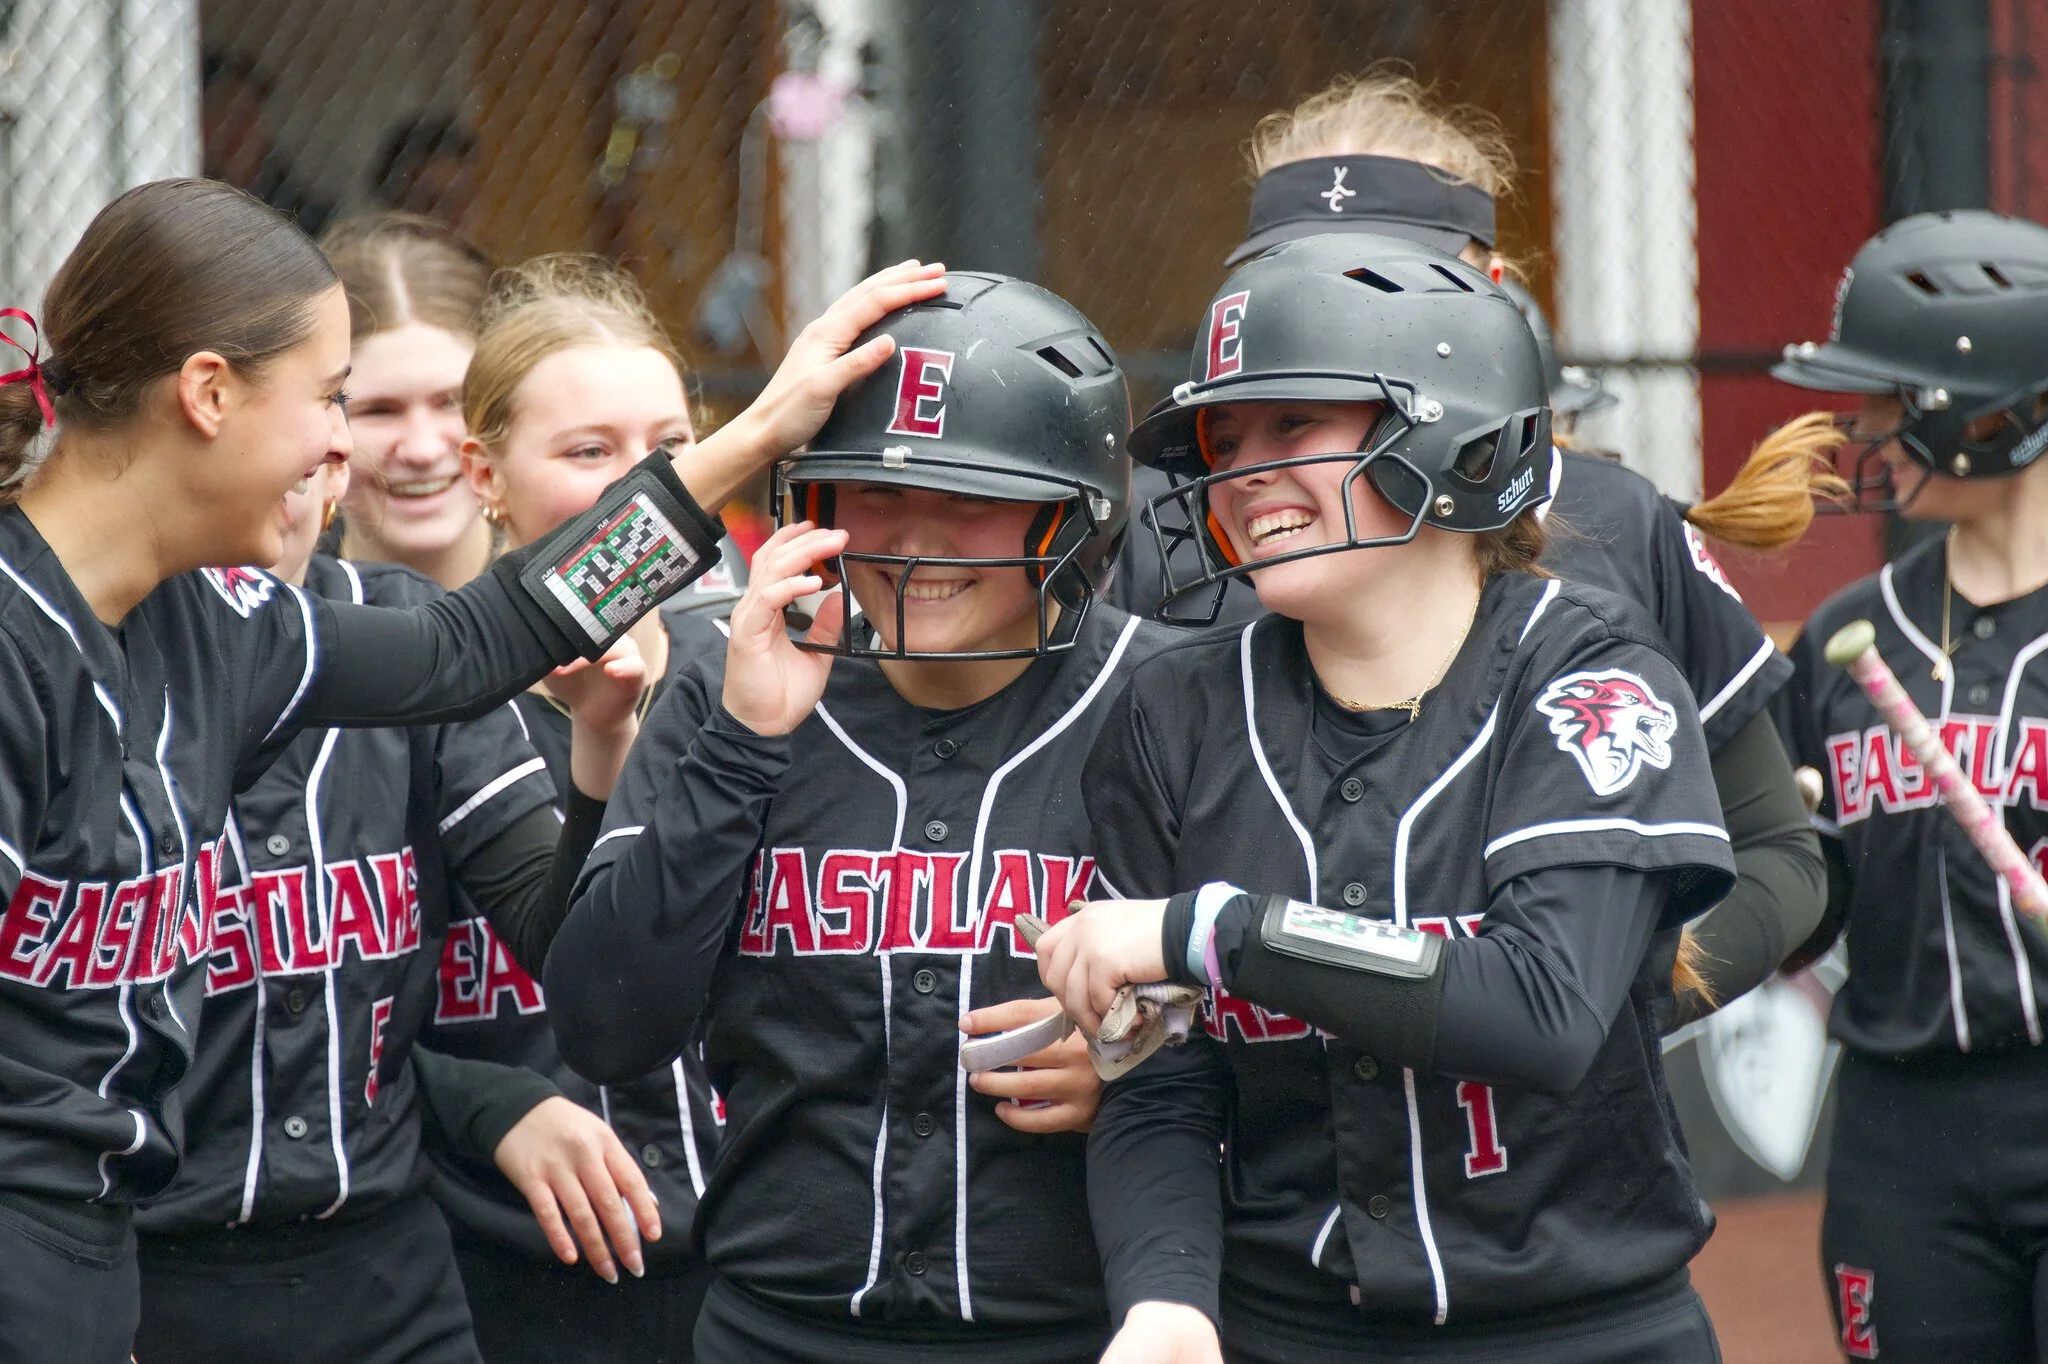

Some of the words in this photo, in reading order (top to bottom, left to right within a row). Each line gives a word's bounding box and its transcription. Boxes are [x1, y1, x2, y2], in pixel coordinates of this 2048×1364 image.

[1205, 290, 1250, 381] E
[885, 346, 955, 439] E
[1498, 466, 1534, 512] schutt
[1825, 712, 2048, 828] EASTLA
[738, 846, 1097, 959] EASTLAK
[1456, 1080, 1507, 1179] 1
[1834, 1262, 1880, 1360] E
